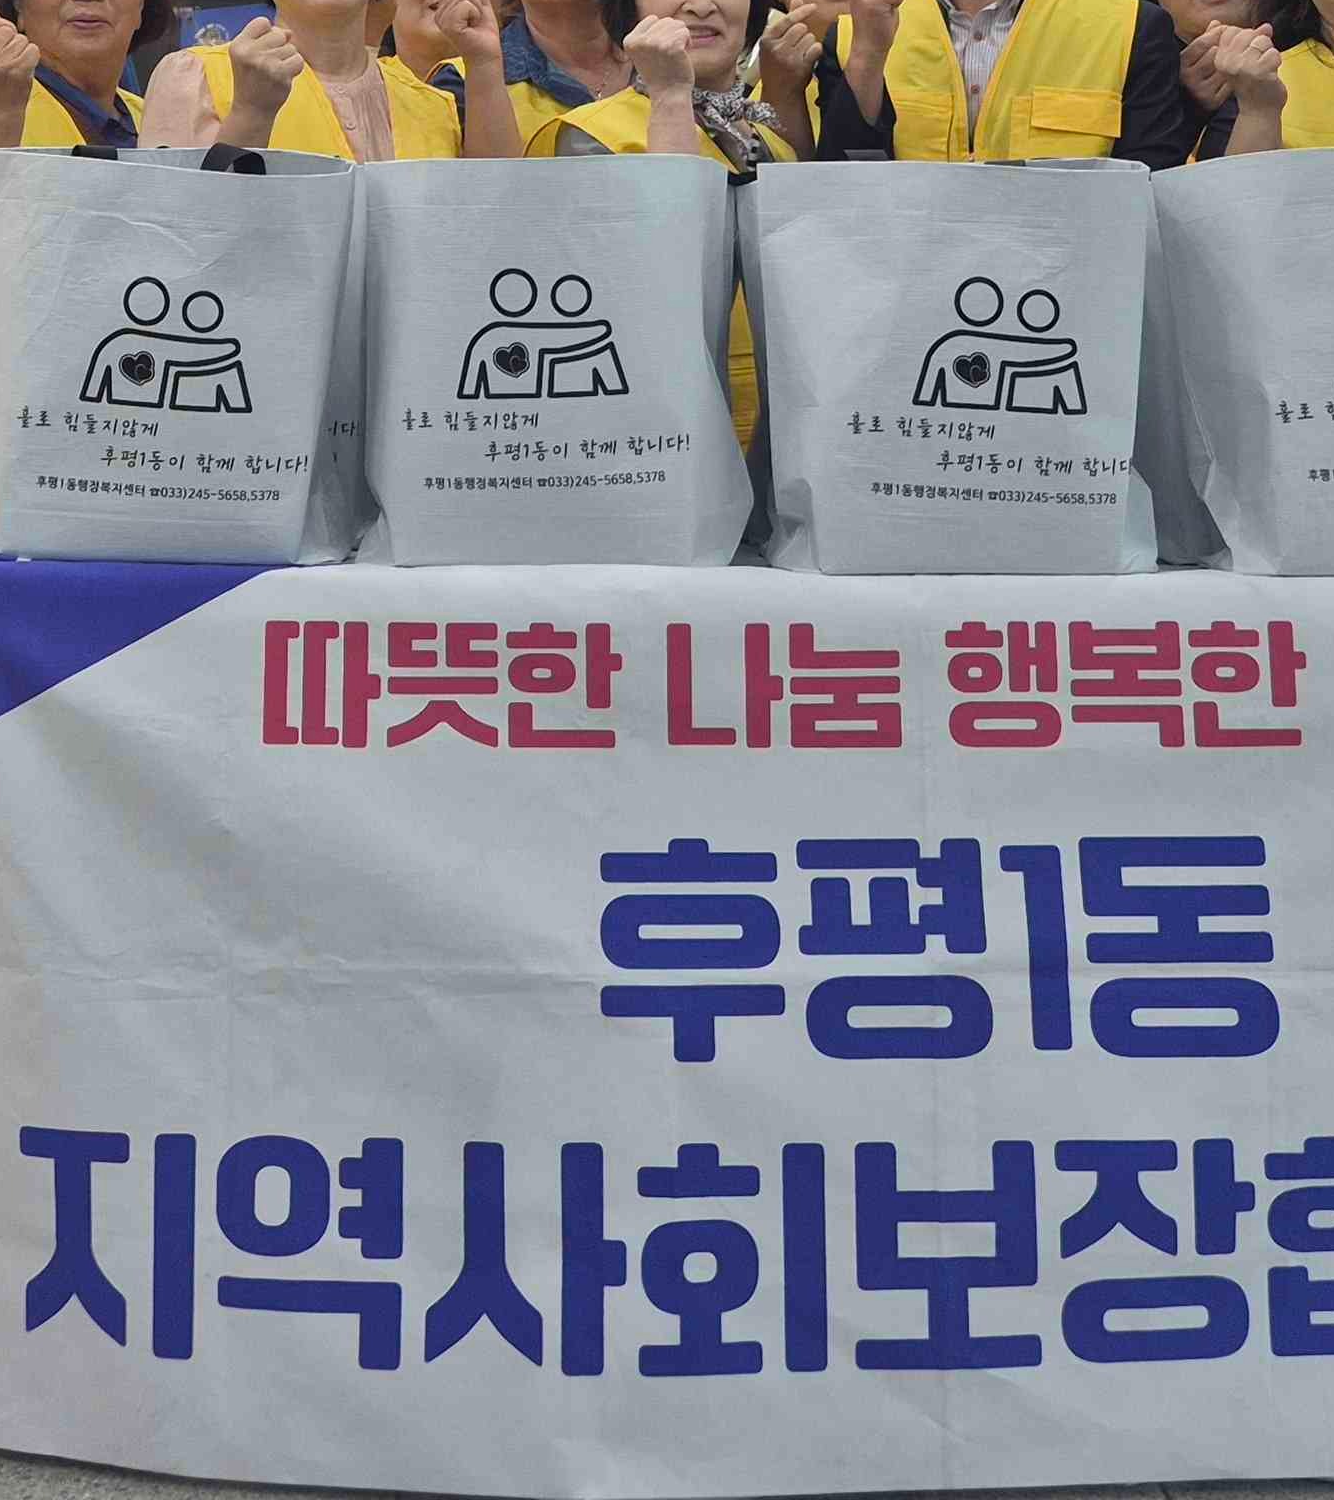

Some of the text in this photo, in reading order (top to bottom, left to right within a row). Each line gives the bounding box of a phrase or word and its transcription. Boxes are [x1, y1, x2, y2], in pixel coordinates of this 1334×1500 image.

[16, 405, 162, 439] 홀로 힘들지않게
[401, 407, 540, 432] 홀로 힘들지않게
[1274, 399, 1315, 424] 홀로
[846, 410, 996, 443] 홀로 힘들지않게
[99, 445, 309, 475] 후평1동이 함께 합니다!
[483, 432, 690, 463] 후평1동이 함께 합니다!
[935, 449, 1024, 475] 후평1동이
[1033, 455, 1074, 477] 함께
[35, 475, 146, 498] 후평1동행정복지센터
[423, 475, 533, 491] 후평1동행정복지센터
[870, 481, 984, 502] 후평1동행정복지센터
[262, 620, 623, 749] 따뜻한
[666, 622, 903, 749] 나눔
[944, 620, 1307, 748] 행복한
[599, 835, 1281, 1063] 후평1동
